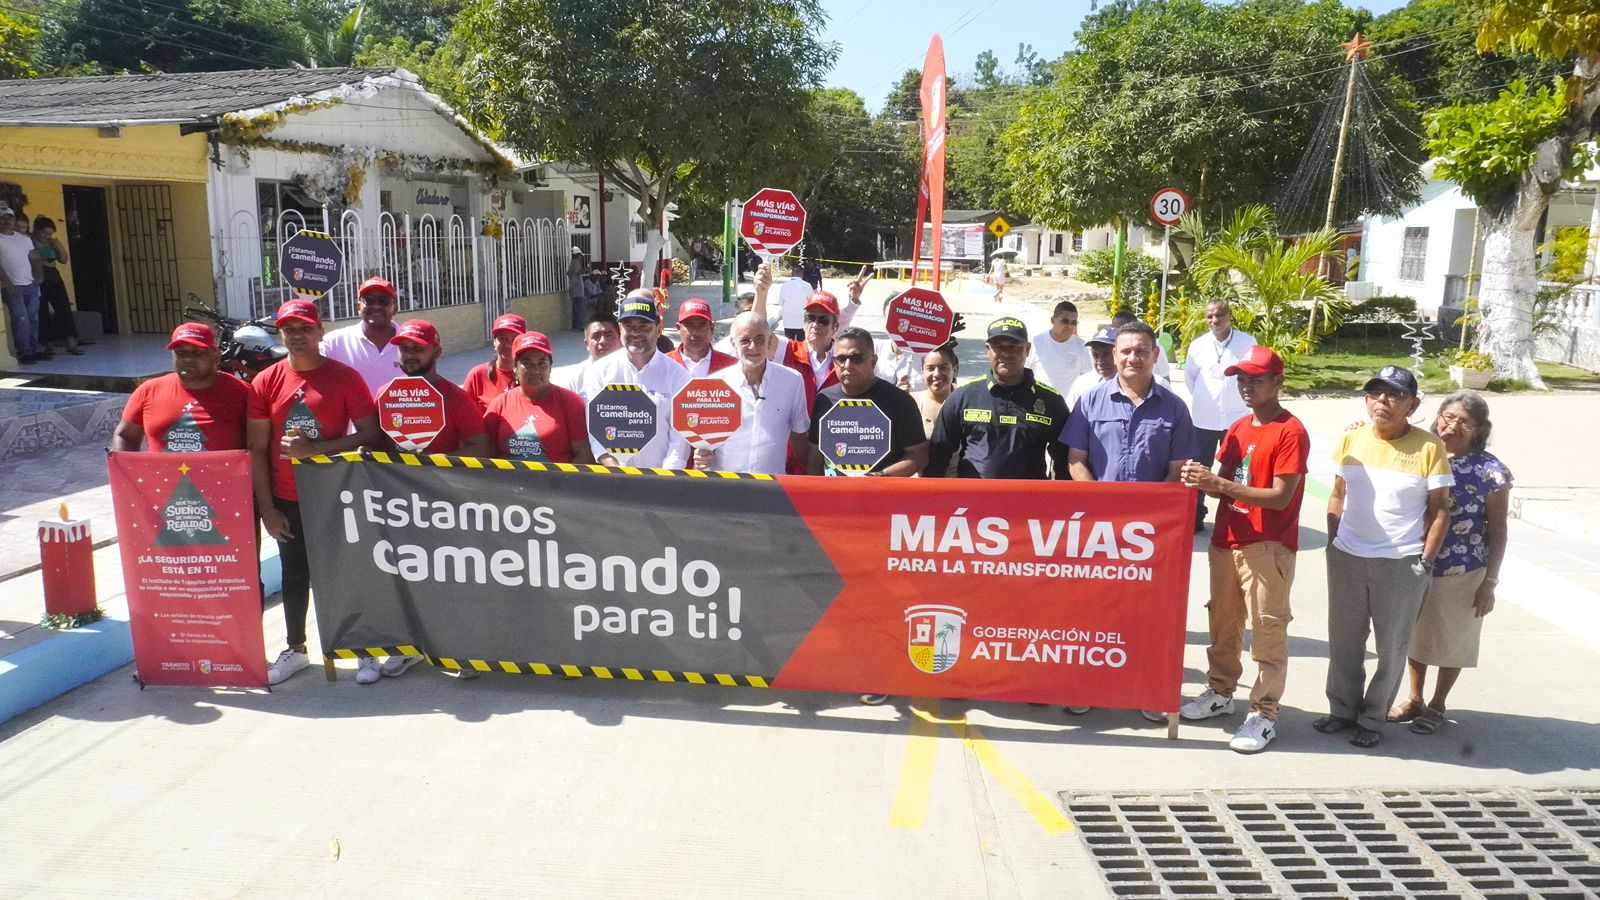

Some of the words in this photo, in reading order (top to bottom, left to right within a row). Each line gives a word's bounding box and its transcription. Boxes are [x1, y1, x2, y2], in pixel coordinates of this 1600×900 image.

[756, 200, 774, 208] MÁS
[777, 201, 796, 211] VÍAS
[1160, 199, 1180, 215] 30
[750, 211, 799, 222] TRANSFORMACIÓN
[903, 297, 921, 307] MÁS
[924, 301, 943, 311] VÍAS
[389, 389, 408, 397] MÁS
[410, 388, 430, 396] VÍAS
[687, 389, 707, 397] MÁS
[709, 389, 730, 397] VÍAS
[596, 404, 627, 412] ¡Estamos
[644, 416, 652, 424] ti!
[827, 420, 859, 428] ¡Estamos
[876, 431, 884, 439] ti!
[166, 505, 208, 516] SUEÑOS
[340, 489, 557, 544] ¡Estamos
[166, 519, 212, 531] REALIDAD
[890, 508, 1009, 556] MÁS
[1027, 512, 1156, 561] VÍAS
[138, 555, 153, 564] ¡LA
[155, 555, 212, 564] SEGURIDAD
[215, 554, 237, 562] VIAL
[162, 566, 185, 575] ESTÁ
[188, 566, 201, 574] EN
[205, 566, 217, 574] TI!
[373, 539, 721, 598] camellando
[887, 557, 937, 574] PARA
[943, 559, 966, 575] LA
[971, 560, 1152, 581] TRANSFORMACIÓN
[574, 604, 674, 641] para
[688, 587, 741, 641] ti!
[973, 626, 1090, 643] GOBERNACIÓN
[1095, 632, 1126, 644] DEL
[971, 639, 1127, 668] ATLÁNTICO
